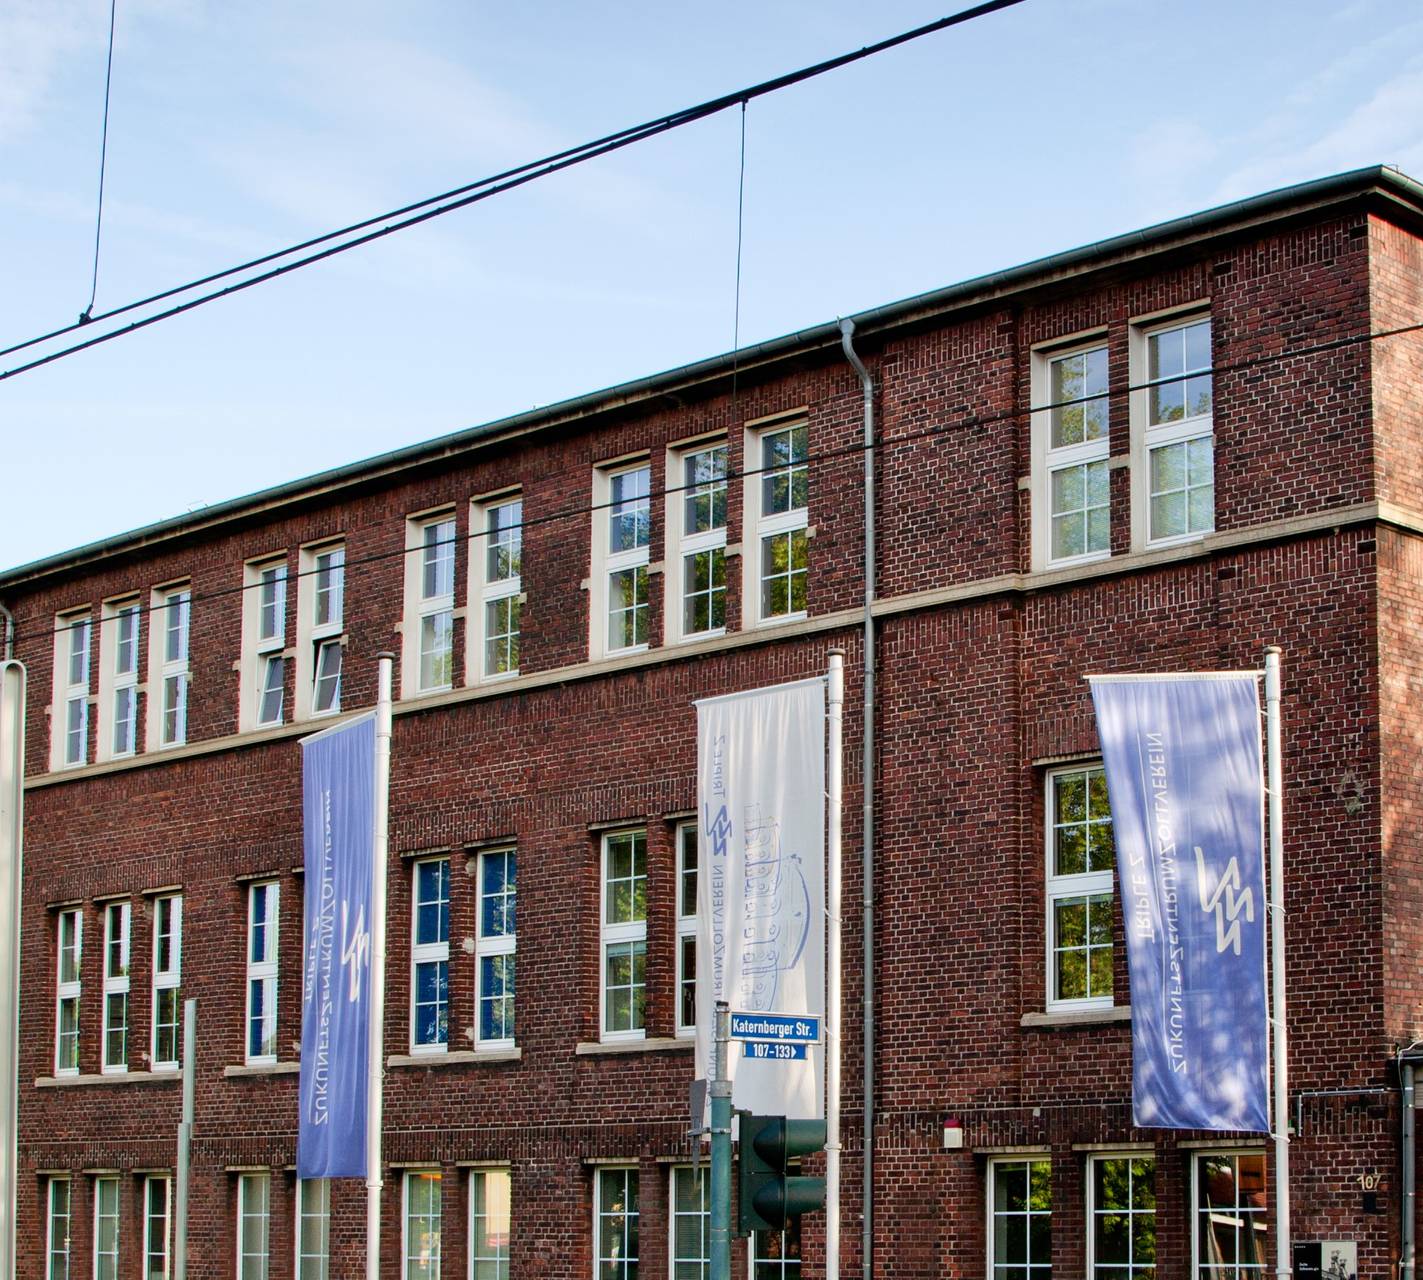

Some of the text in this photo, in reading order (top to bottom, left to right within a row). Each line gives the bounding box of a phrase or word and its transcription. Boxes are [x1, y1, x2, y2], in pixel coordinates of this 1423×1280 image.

[732, 1017, 813, 1038] Katernberger Str.
[753, 1042, 791, 1058] 107-133
[1356, 1174, 1381, 1191] 107
